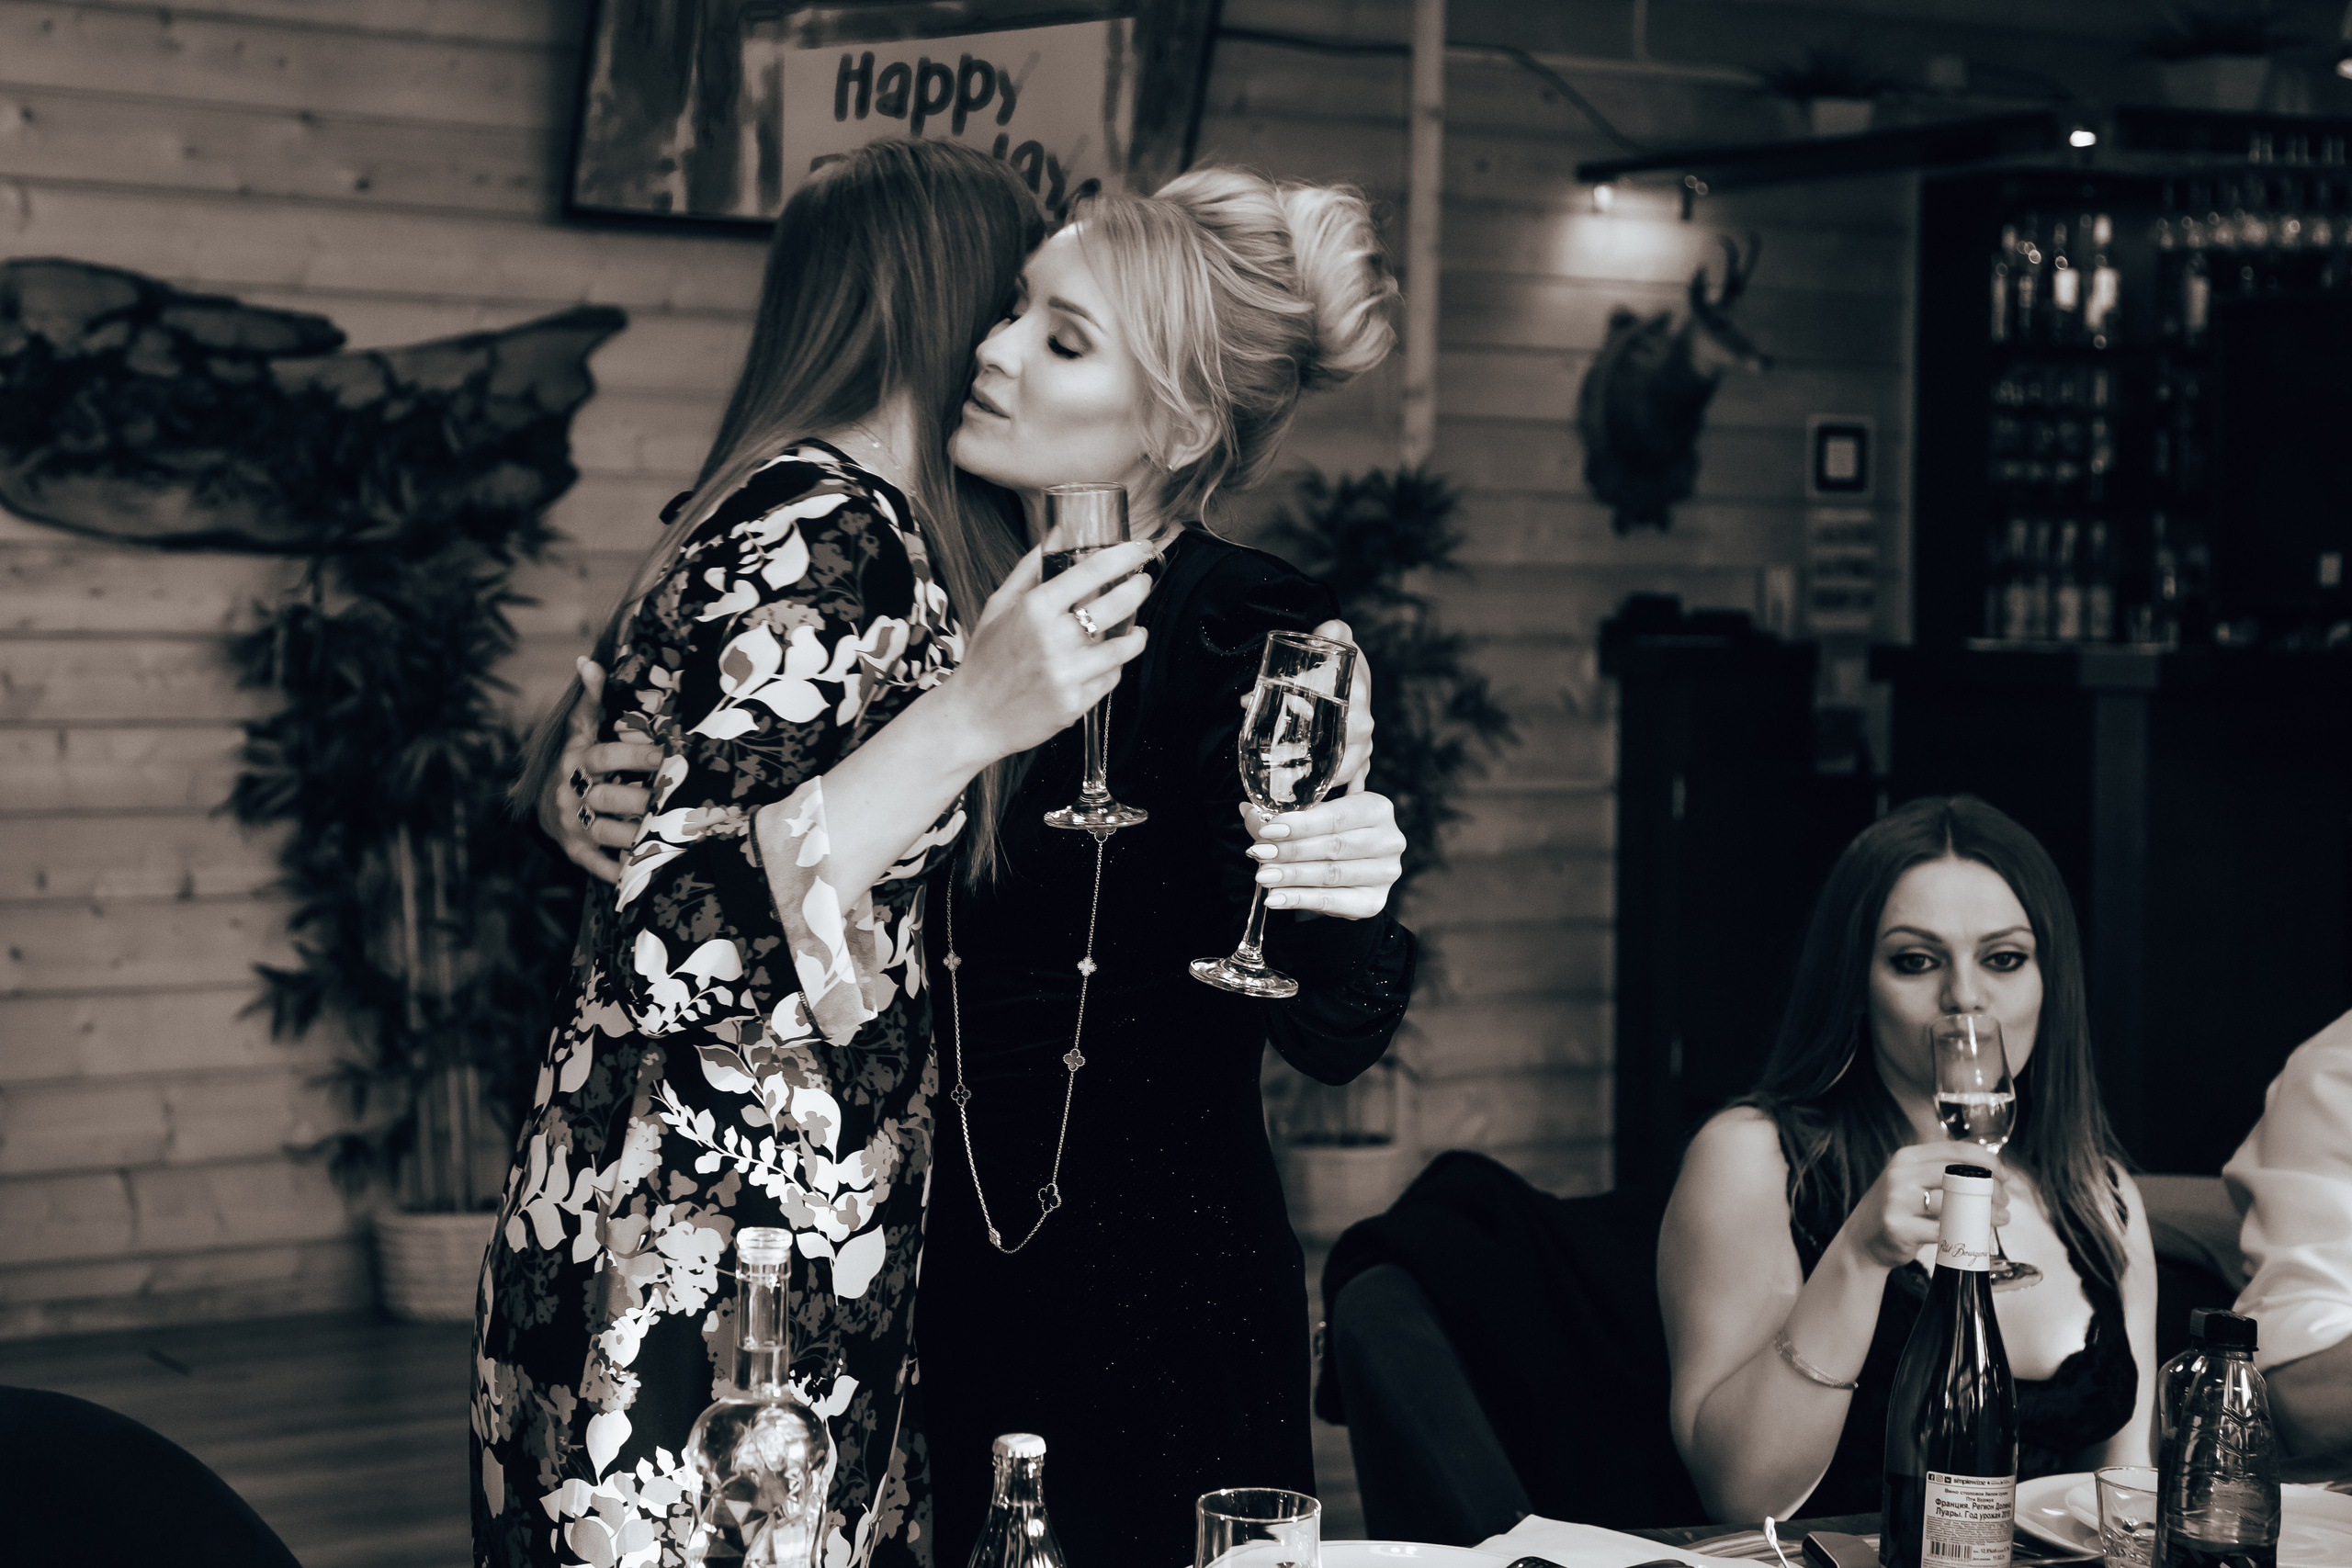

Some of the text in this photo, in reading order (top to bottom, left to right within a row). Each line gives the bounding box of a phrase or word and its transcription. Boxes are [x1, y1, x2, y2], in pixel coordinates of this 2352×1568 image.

[833, 51, 1041, 136] Happy
[1935, 1497, 1970, 1509] Франция.
[1972, 1502, 1995, 1510] Регион
[1936, 1506, 1962, 1518] Луары.
[1964, 1511, 1978, 1519] Год
[1980, 1512, 2001, 1520] урожая
